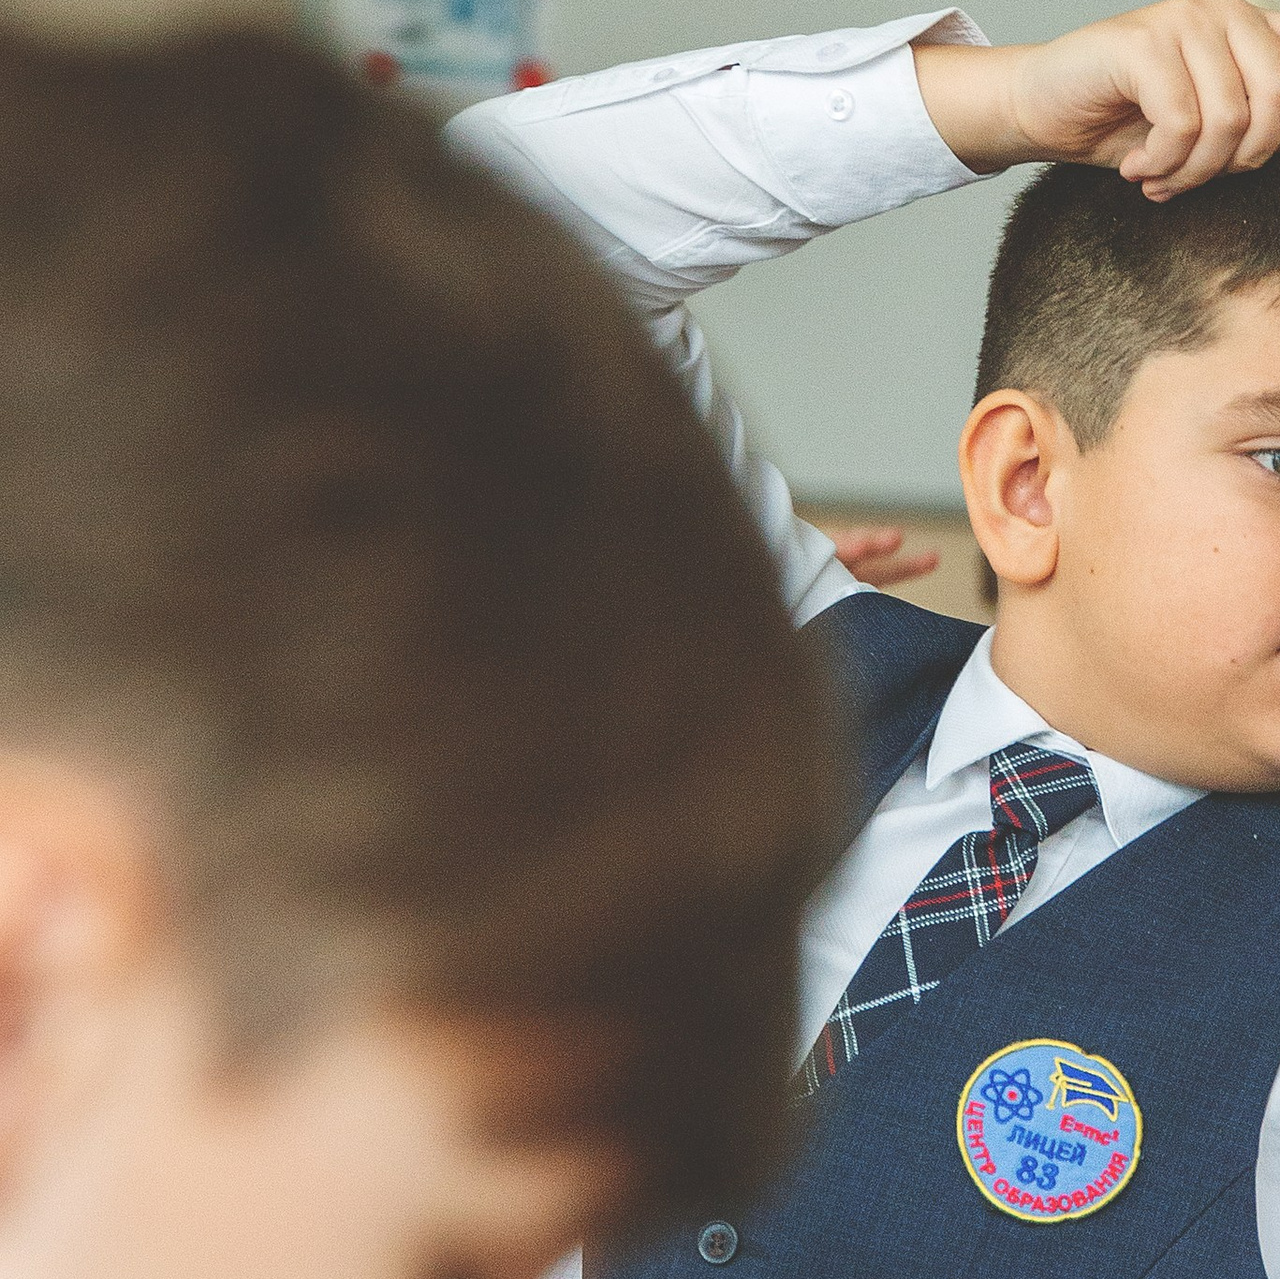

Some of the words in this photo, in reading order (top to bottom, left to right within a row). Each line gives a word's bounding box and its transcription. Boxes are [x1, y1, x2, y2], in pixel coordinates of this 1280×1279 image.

[965, 1100, 997, 1175] ЦЕНТР
[992, 1150, 1129, 1213] ОБРАЗОВАНИЯ
[1006, 1124, 1088, 1166] ЛИЦЕЙ
[1016, 1155, 1060, 1191] 83
